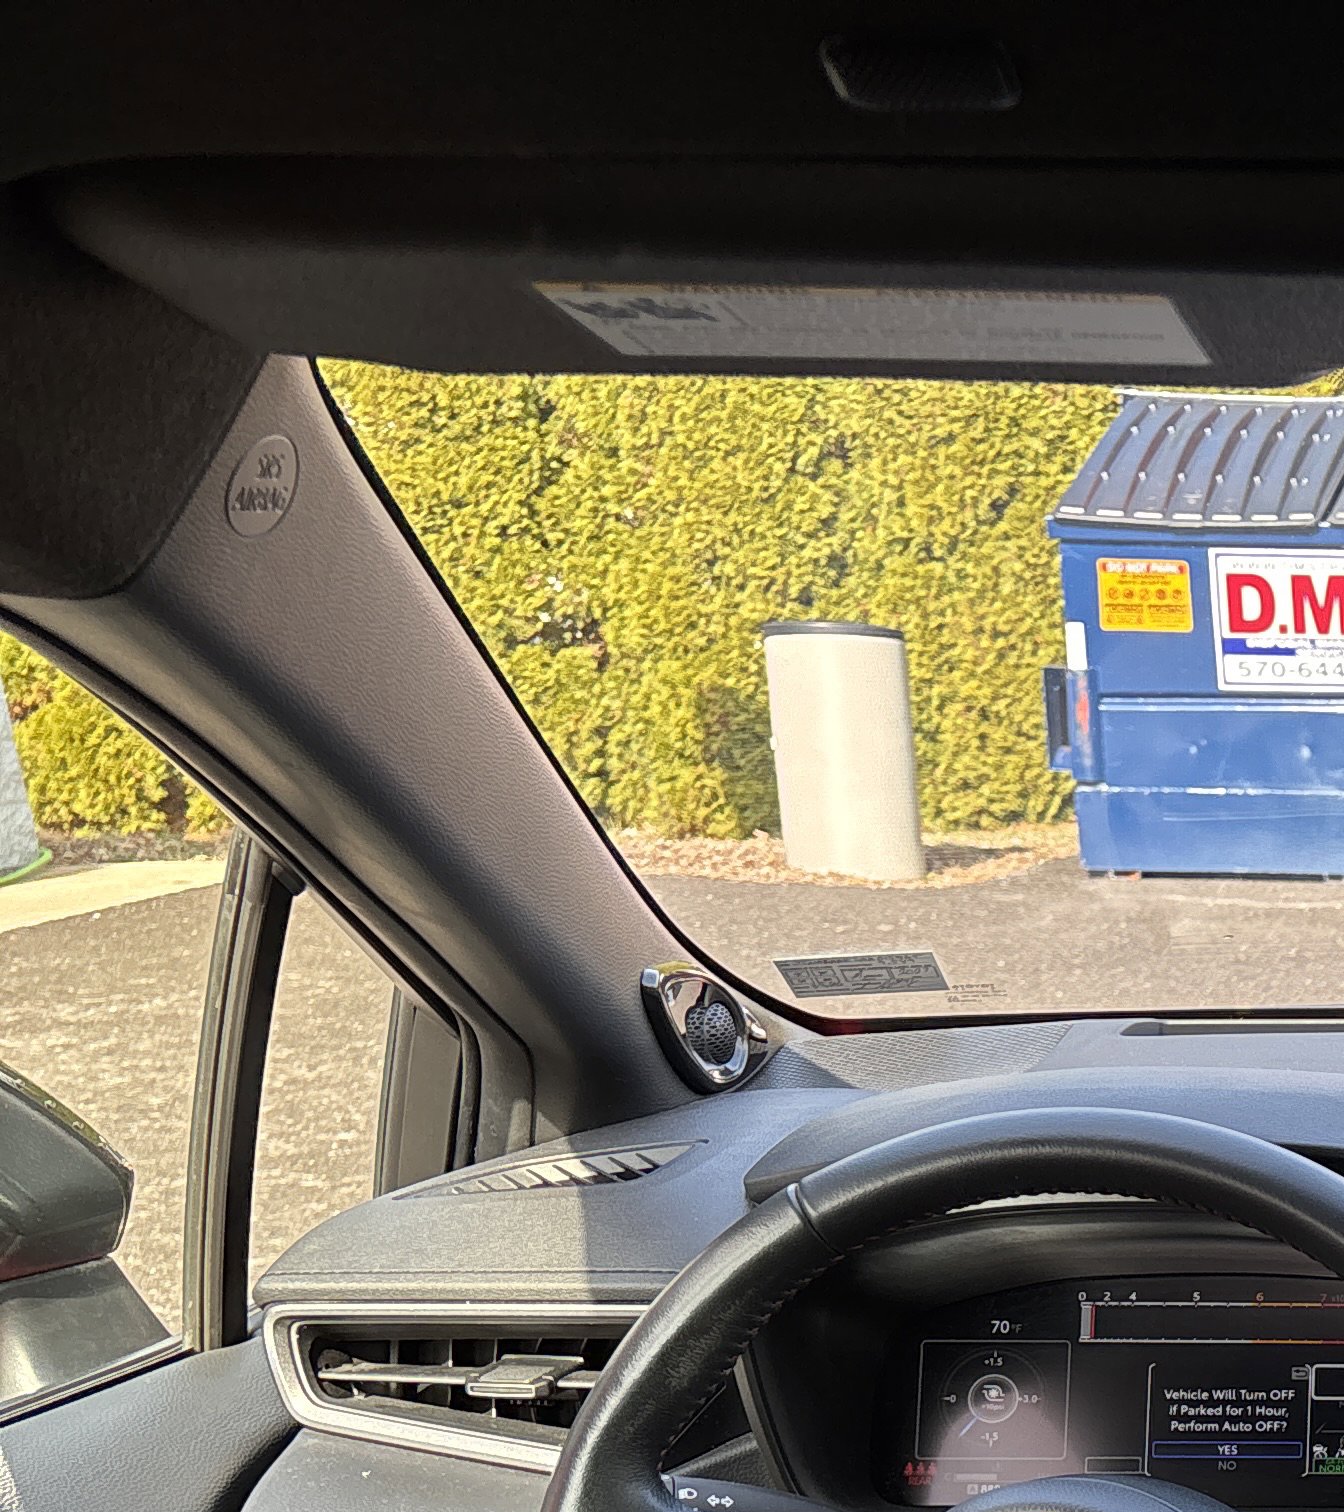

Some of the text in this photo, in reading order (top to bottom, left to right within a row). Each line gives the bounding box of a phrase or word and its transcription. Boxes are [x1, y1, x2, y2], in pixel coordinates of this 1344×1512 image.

[1078, 1291, 1087, 1301] 0
[1103, 1291, 1111, 1301] 2
[1129, 1291, 1137, 1301] 4
[1192, 1291, 1201, 1301] 5
[1256, 1291, 1264, 1301] 6
[1164, 1389, 1296, 1401] Vehicle Will Turn OFF
[1168, 1405, 1290, 1418] If Parked for 1 Hour,
[1170, 1421, 1288, 1433] Perform Auto OFF?
[1217, 1445, 1238, 1456] YES
[1217, 1460, 1237, 1471] NO
[908, 1476, 932, 1485] REAR
